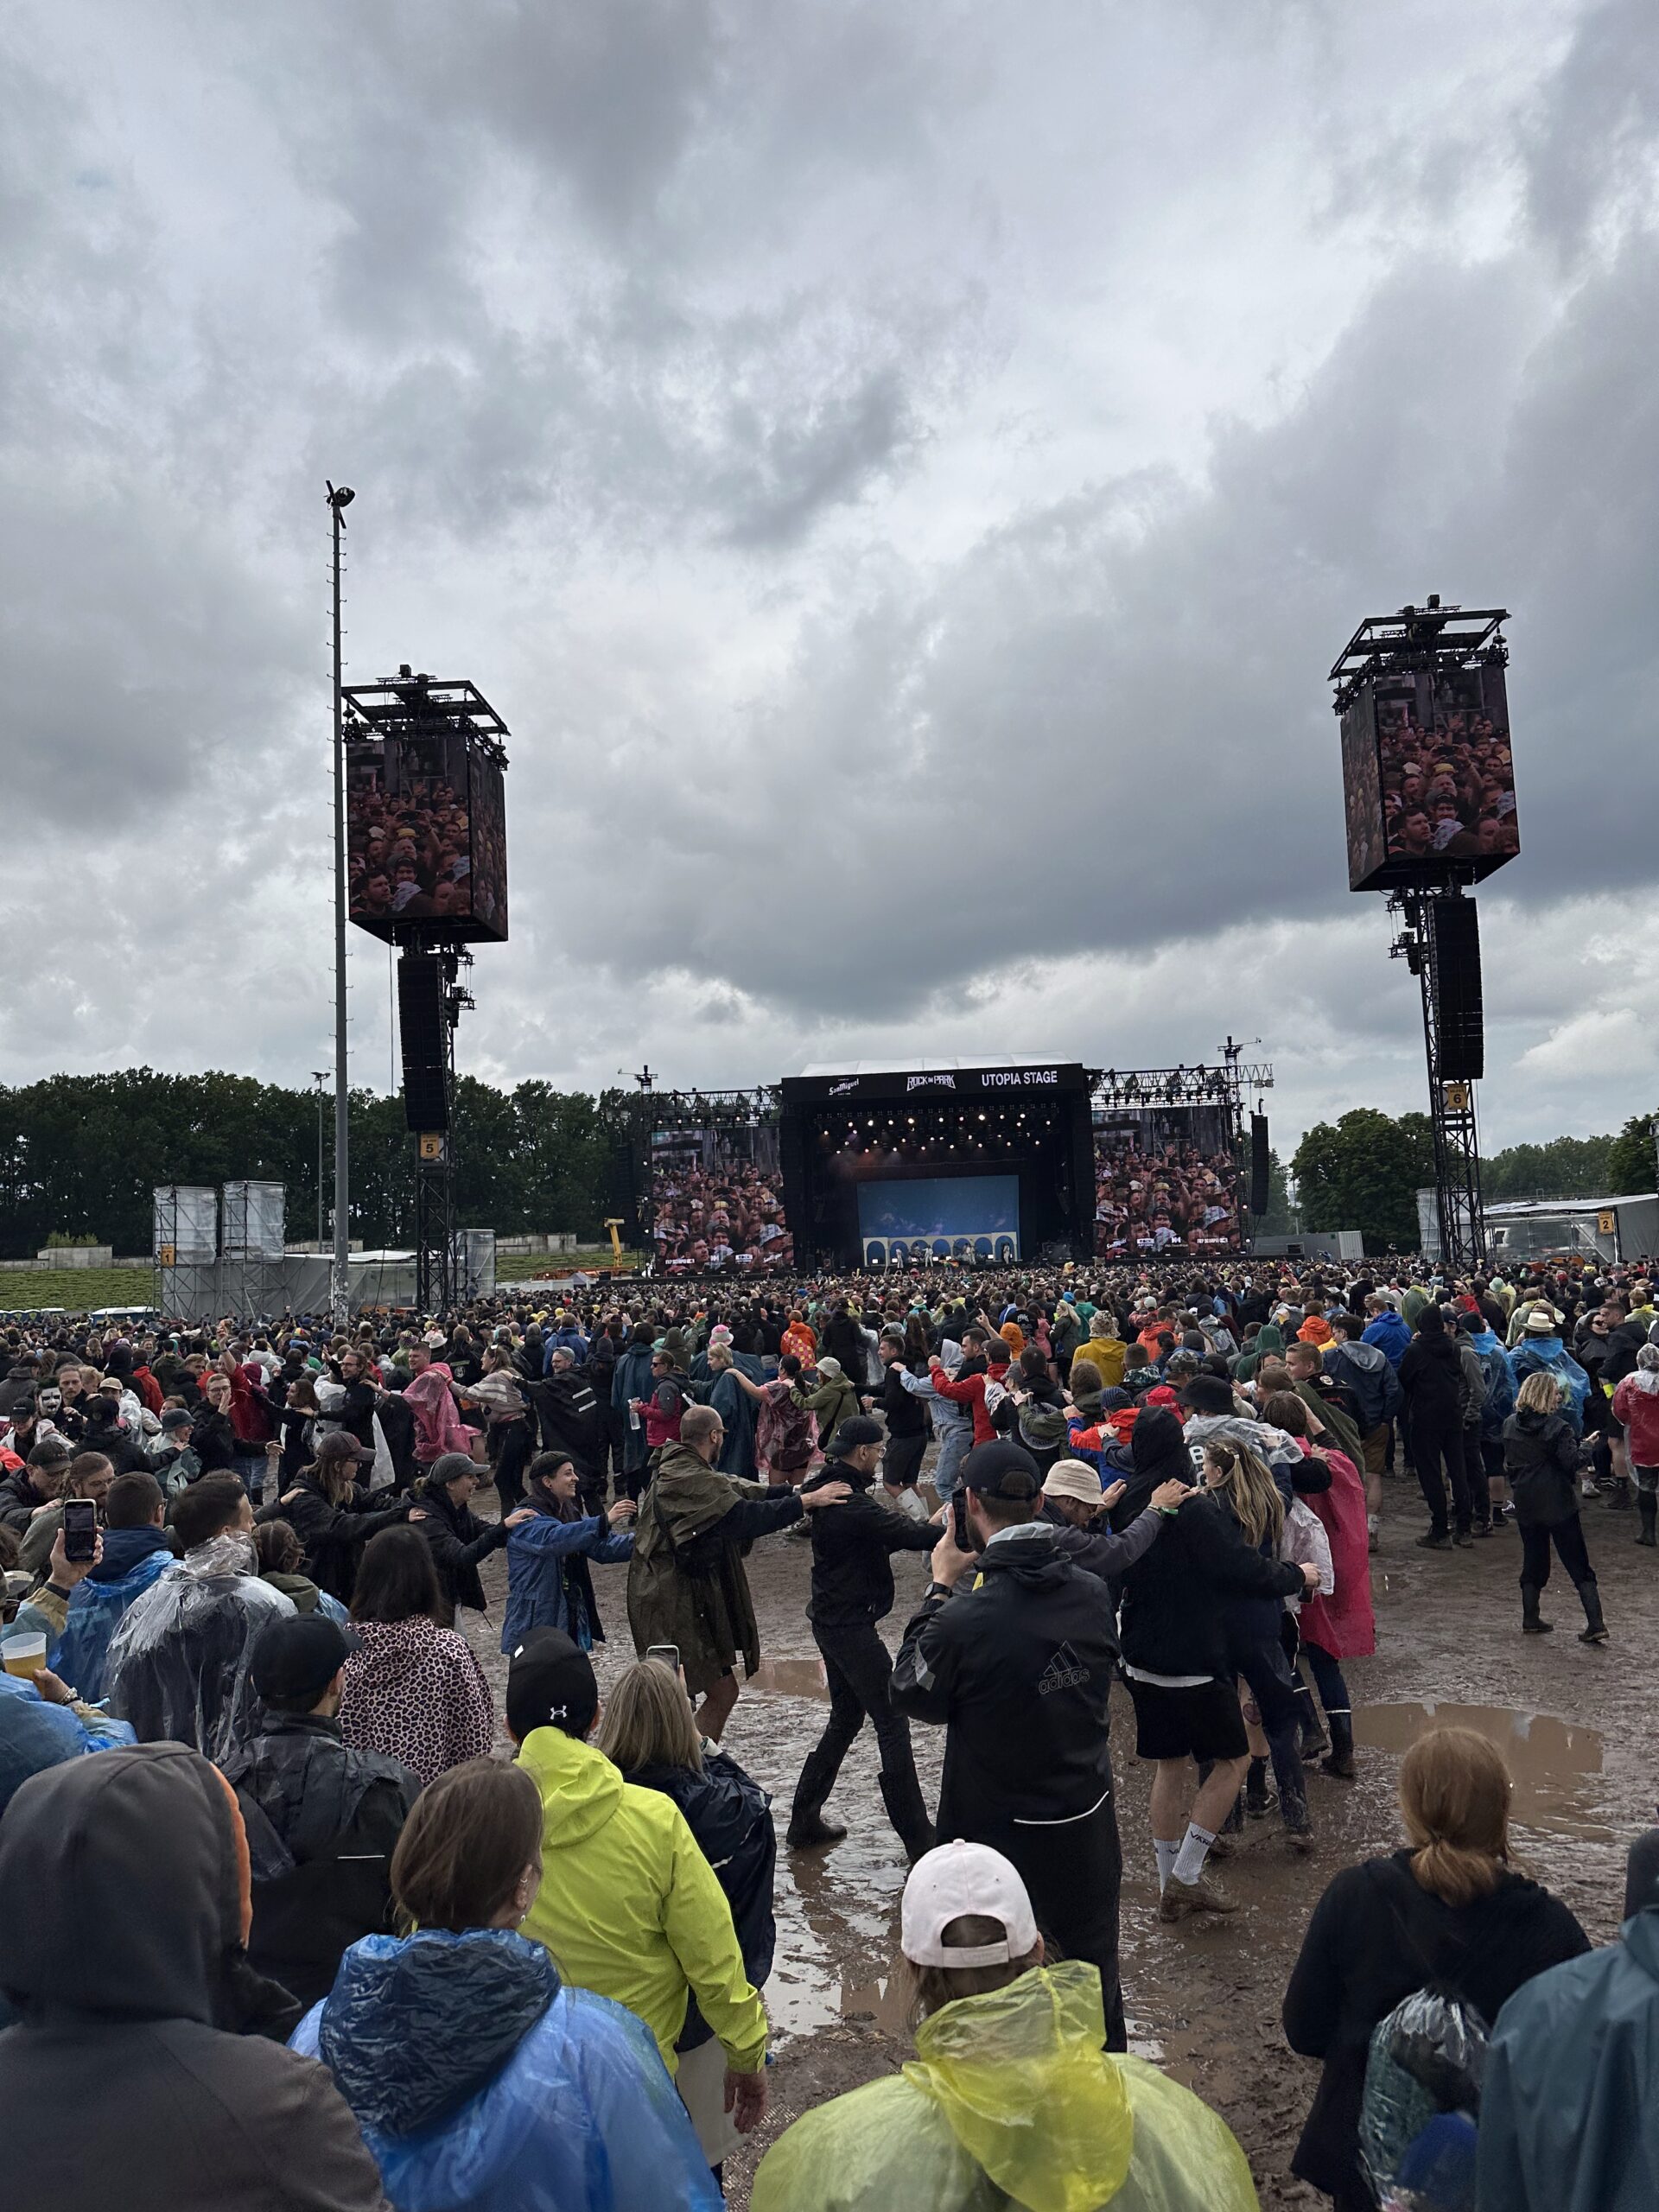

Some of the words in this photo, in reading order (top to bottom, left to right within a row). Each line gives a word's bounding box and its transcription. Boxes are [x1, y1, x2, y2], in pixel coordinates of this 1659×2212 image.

[906, 1076, 928, 1091] ROCK
[933, 1074, 957, 1089] PARK
[982, 1073, 1021, 1086] UTOPIA
[1023, 1071, 1058, 1084] STAGE
[1453, 1093, 1462, 1104] 6
[426, 1143, 434, 1154] 5
[1603, 1220, 1610, 1230] 2
[165, 1254, 169, 1262] 1
[1039, 1669, 1090, 1694] adidas
